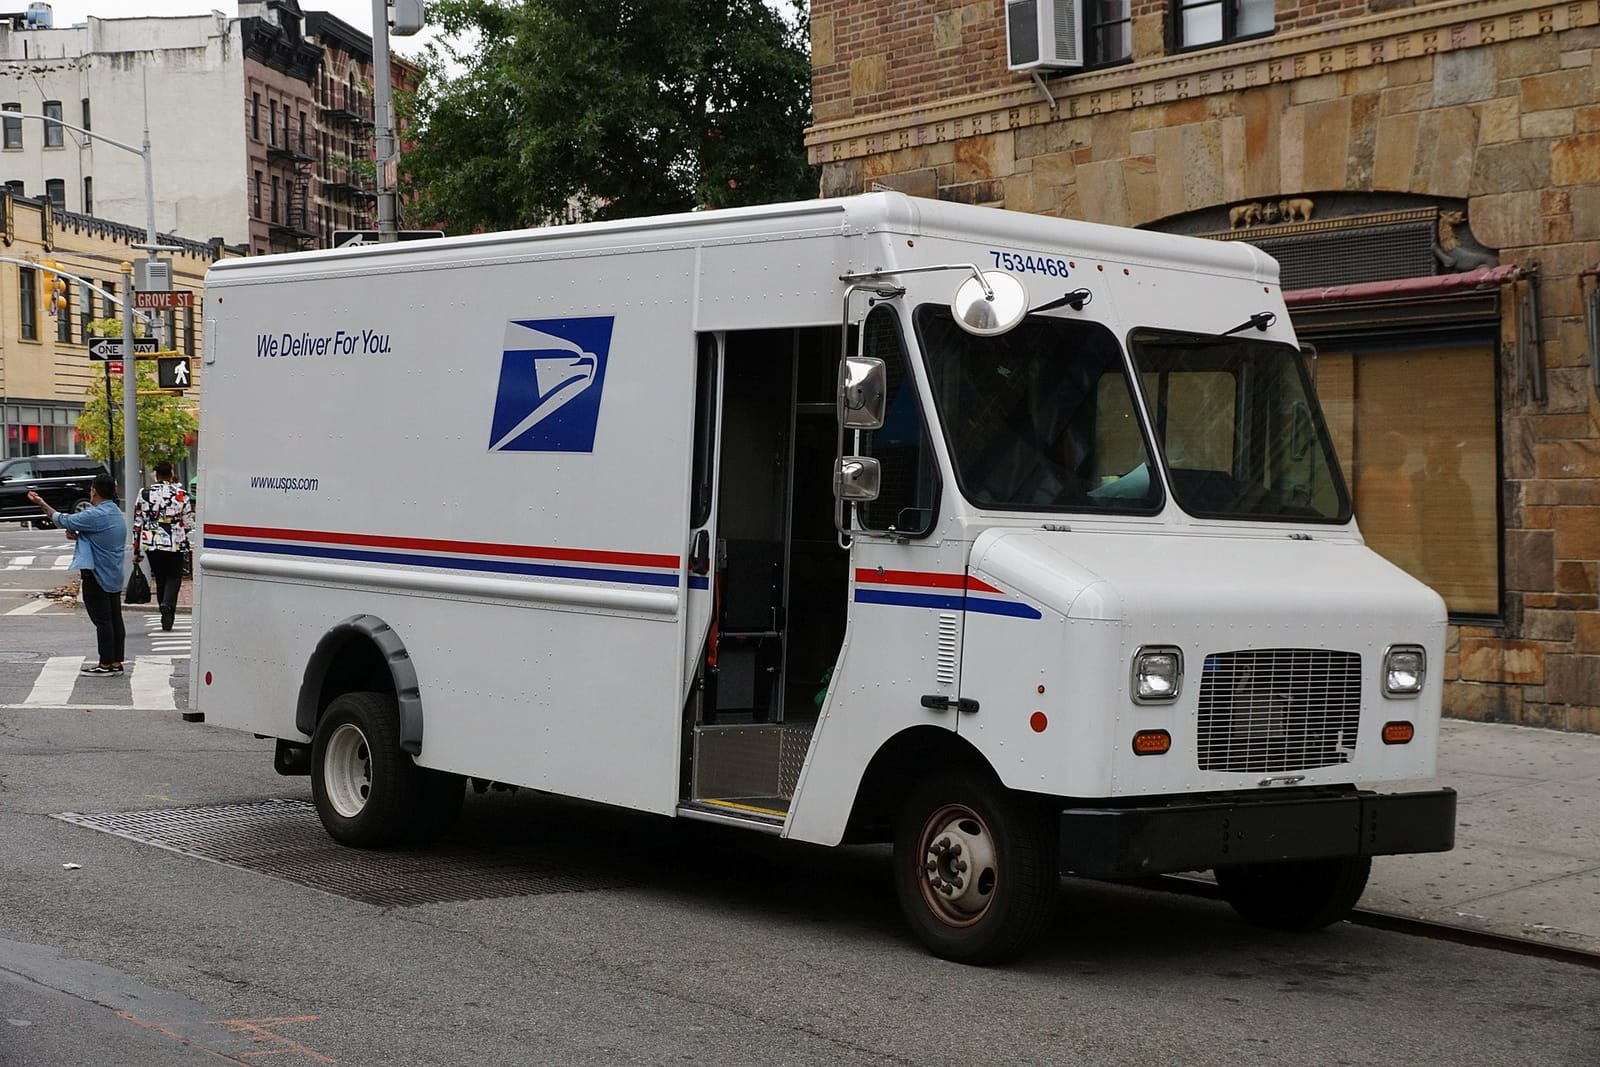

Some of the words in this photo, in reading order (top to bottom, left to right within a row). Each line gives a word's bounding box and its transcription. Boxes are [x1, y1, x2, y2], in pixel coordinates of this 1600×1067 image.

[989, 251, 1069, 278] 7534468
[137, 293, 172, 307] GROVE
[177, 293, 190, 307] ST
[98, 345, 119, 354] ONE
[257, 334, 278, 357] We
[280, 332, 332, 357] Deliver
[333, 330, 359, 355] For
[361, 329, 391, 354] You.
[250, 476, 319, 493] www.usps.com
